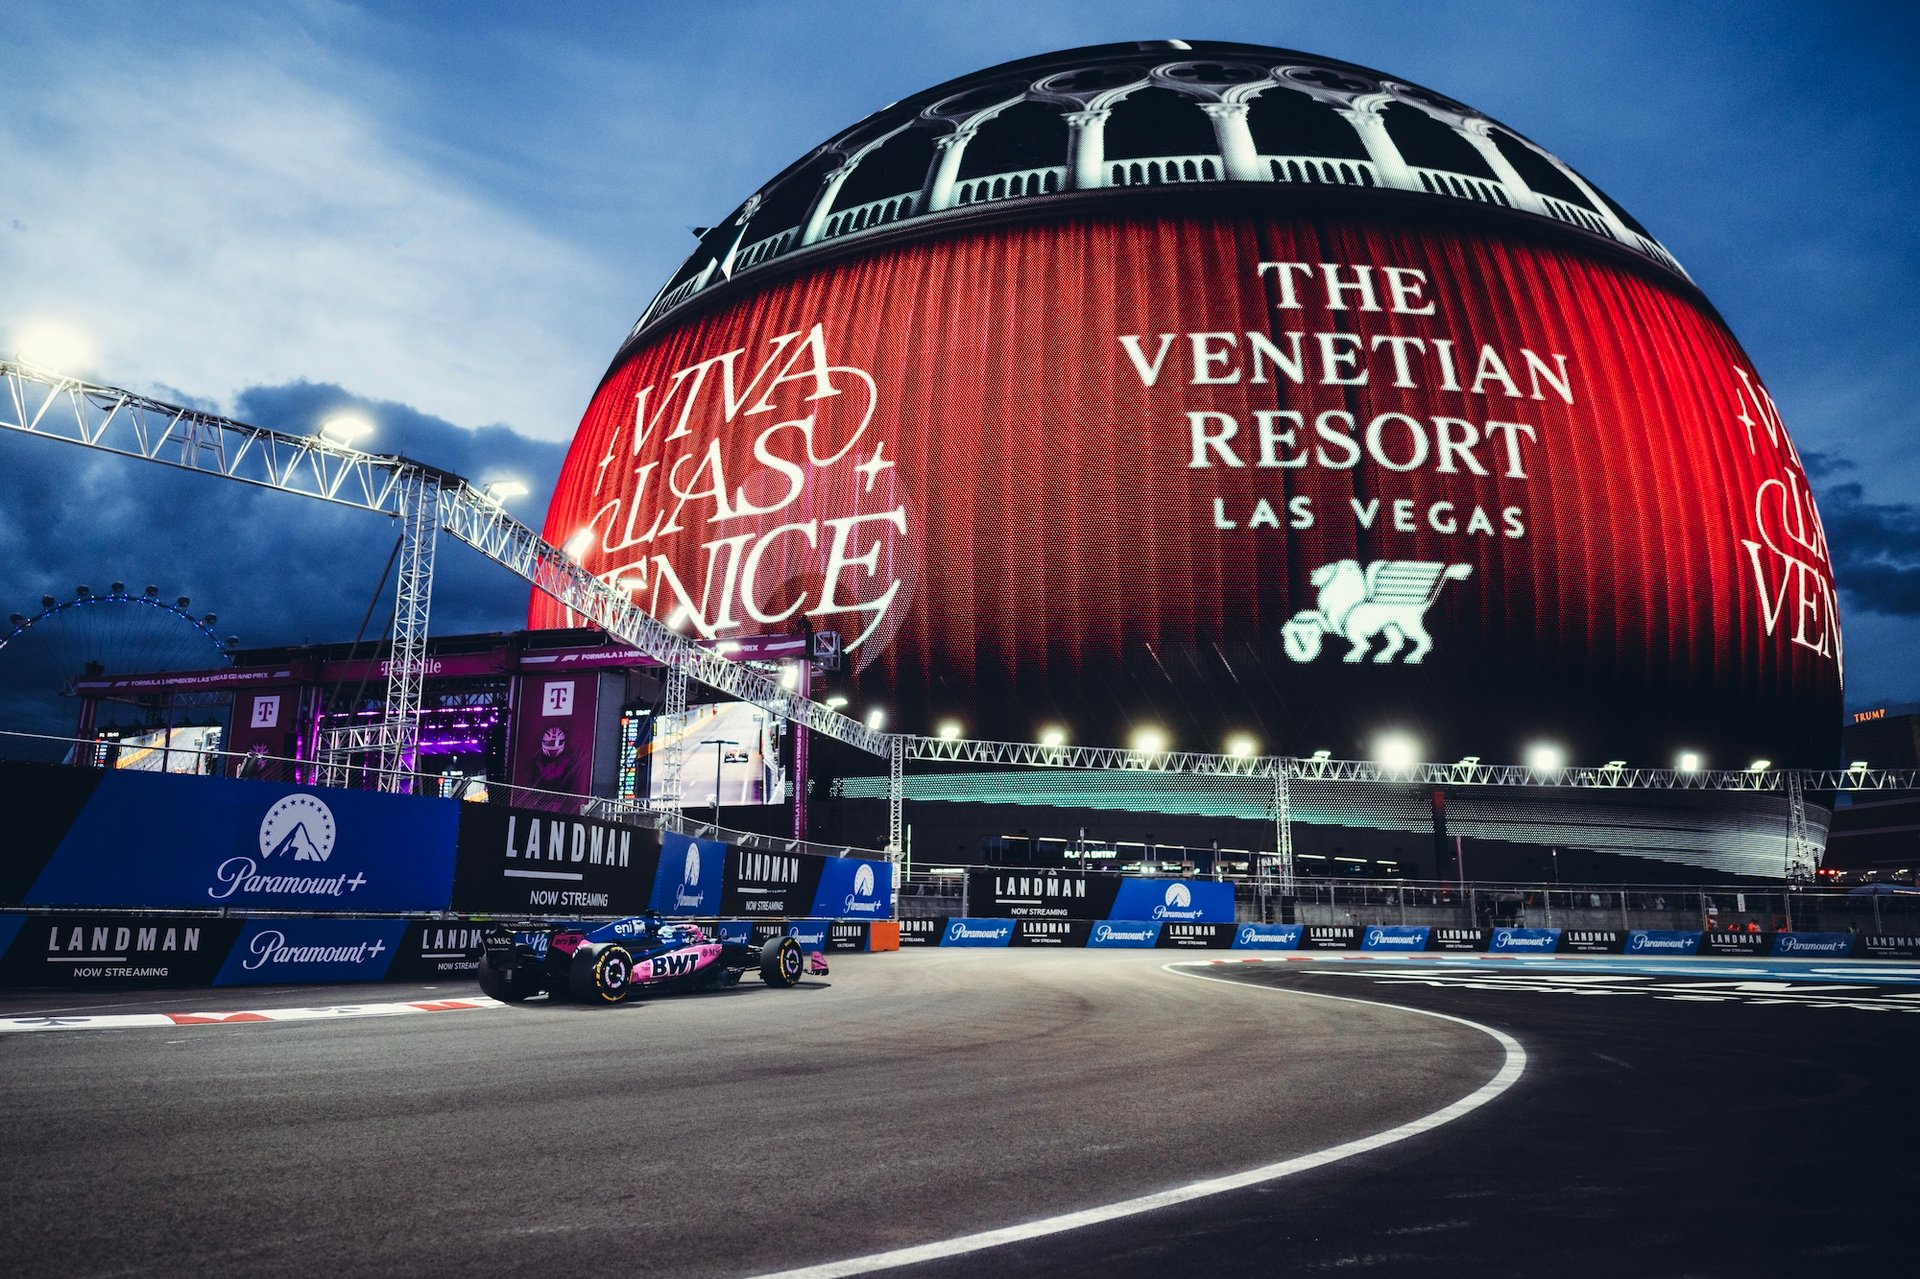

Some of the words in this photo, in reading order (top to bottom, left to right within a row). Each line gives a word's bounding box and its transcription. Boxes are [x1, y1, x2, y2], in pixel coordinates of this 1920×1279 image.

[1257, 261, 1436, 316] THE
[1118, 331, 1575, 406] VENETIAN
[635, 322, 870, 459] VIVA
[1733, 365, 1803, 468] VI
[1185, 410, 1537, 479] RESORT
[590, 414, 814, 554] LAS
[1213, 495, 1315, 531] LAS
[1350, 498, 1526, 540] VEGAS
[1741, 539, 1844, 690] VEN
[581, 651, 618, 660] FORMULA
[131, 679, 161, 687] FORMULA
[228, 672, 253, 680] GRAND
[550, 687, 568, 710] T
[258, 701, 274, 722] T
[1853, 708, 1886, 723] TRUMP
[506, 815, 631, 868] LANDMAN
[1064, 850, 1091, 859] PLAA
[738, 851, 800, 883] LANDMAN
[208, 856, 367, 899] Paramount+
[995, 876, 1086, 898] LANDMAN
[530, 890, 559, 906] NOW
[560, 891, 609, 907] STREAMING
[674, 883, 704, 910] Paramount+
[843, 893, 882, 914] Paramount+
[745, 900, 757, 911] NOW
[757, 901, 784, 911] STREAMING
[1029, 908, 1068, 916] STREAMING
[1152, 904, 1203, 920] Paramount+
[614, 921, 633, 934] eni
[832, 925, 862, 937] LANDMAN
[899, 920, 934, 932] NDMAN
[950, 922, 1008, 941] Paramount+
[1023, 922, 1070, 934] LANDMAN
[1095, 924, 1154, 943] Paramount+
[1169, 924, 1216, 936] LANDMAN
[1310, 927, 1354, 938] LANDMAN
[1436, 929, 1482, 940] LANDMAN
[48, 926, 201, 951] LANDMAN
[422, 929, 483, 949] LANDM
[493, 937, 512, 945] MSC
[1240, 927, 1297, 945] Paramount+
[1368, 929, 1423, 947] Paramount+
[1496, 931, 1554, 948] Paramount+
[1568, 931, 1617, 942] LANDMAN
[1632, 934, 1695, 950] Paramount+
[1710, 934, 1763, 944] LANDMAN
[1779, 936, 1848, 953] Paramount+
[1865, 936, 1920, 947] LANDMAN
[242, 930, 387, 970] Paramount+
[73, 967, 103, 977] NOW
[104, 967, 169, 977] STREAMING
[454, 962, 481, 970] STREAM
[652, 953, 700, 977] BWT
